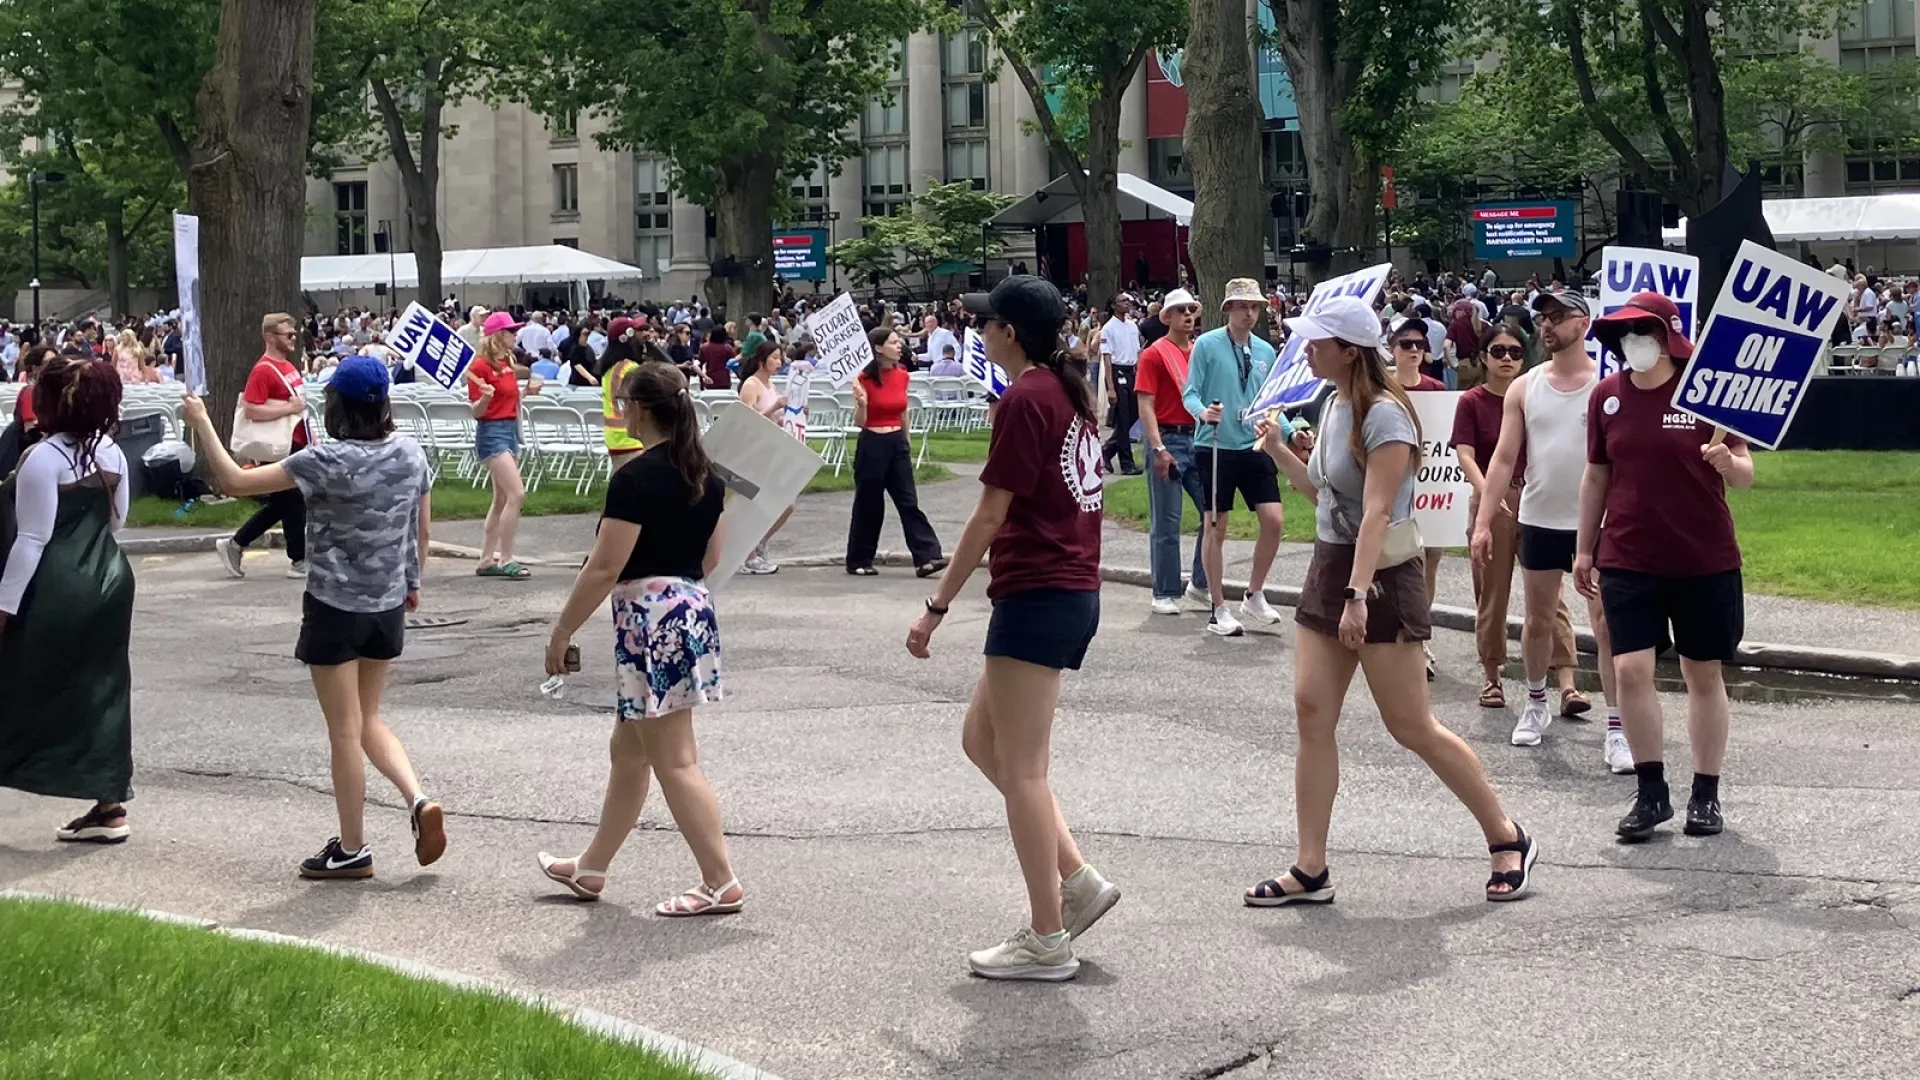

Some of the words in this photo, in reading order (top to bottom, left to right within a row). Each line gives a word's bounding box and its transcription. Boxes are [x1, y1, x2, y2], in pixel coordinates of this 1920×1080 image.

[1494, 222, 1506, 230] sign
[1607, 260, 1692, 299] UAW
[1732, 258, 1839, 332] UAW
[394, 308, 432, 353] UAW
[814, 304, 855, 344] STUDENT
[819, 319, 862, 356] WORKERS
[425, 335, 445, 361] ON
[436, 334, 464, 386] STRIKE
[829, 341, 872, 382] STRIKE
[970, 335, 986, 381] UAW
[1735, 333, 1786, 372] ON
[1686, 368, 1798, 416] STRIKE
[1662, 413, 1696, 425] HGSU
[1422, 441, 1453, 457] EAL
[1417, 466, 1470, 483] OURS
[1416, 492, 1454, 510] OW!
